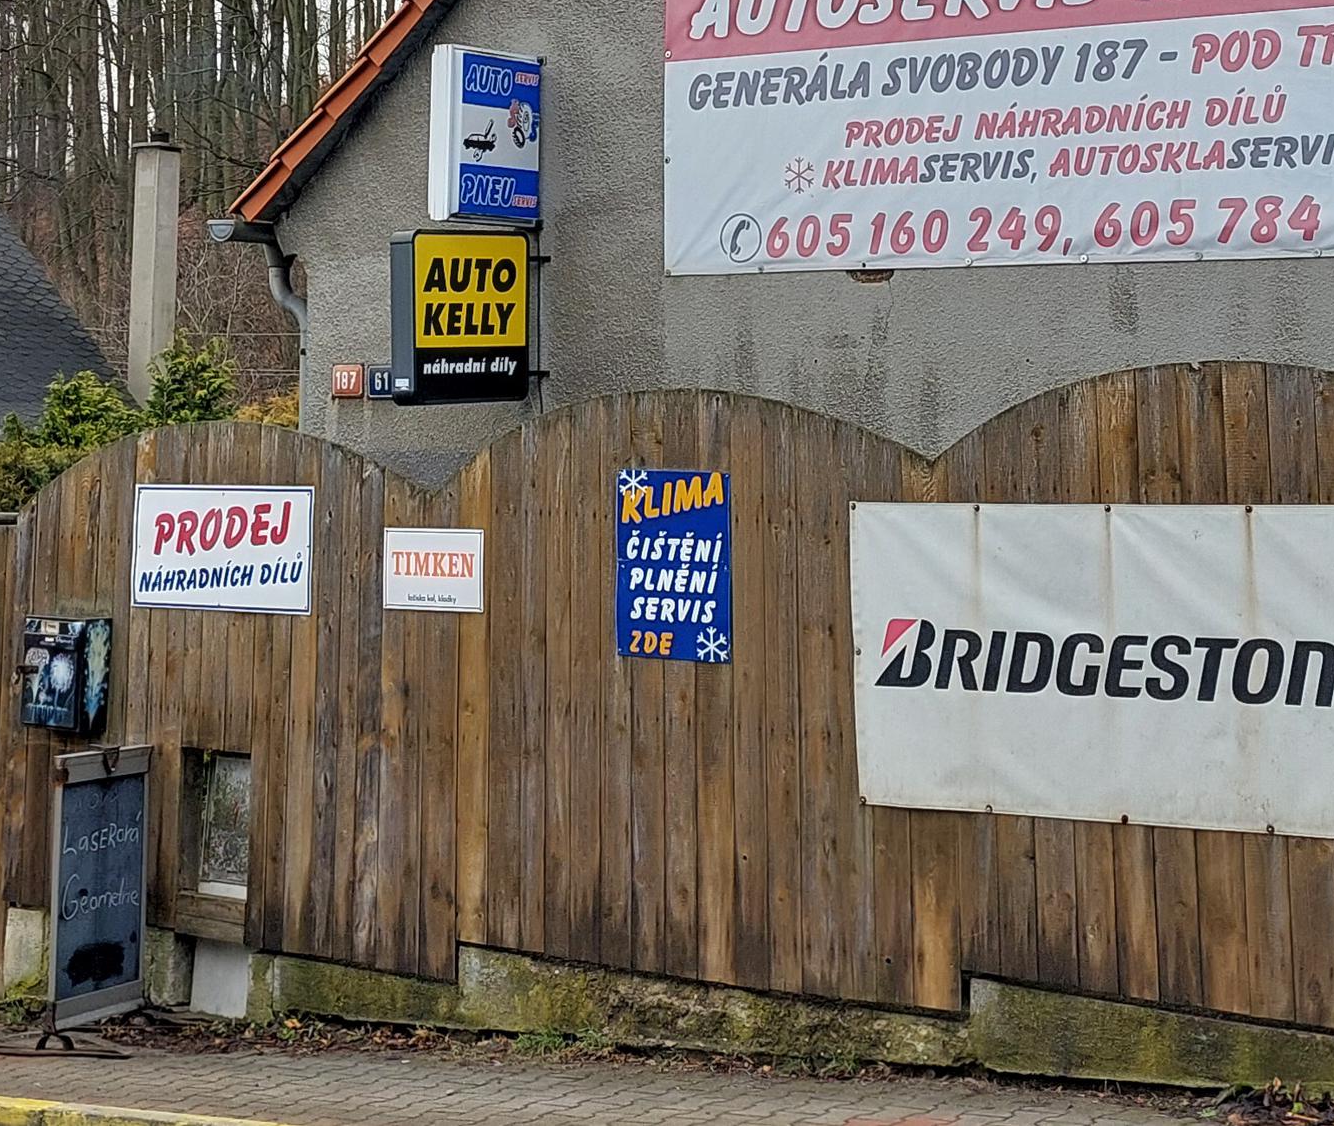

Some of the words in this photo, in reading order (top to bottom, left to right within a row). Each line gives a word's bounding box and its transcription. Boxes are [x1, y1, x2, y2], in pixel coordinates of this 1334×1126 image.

[465, 64, 514, 96] AUTO
[515, 71, 540, 87] SERVIS
[688, 52, 871, 111] GENERÁLA
[880, 45, 1065, 97] SVOBODY
[1074, 39, 1148, 83] 187
[1191, 29, 1282, 75] POD
[845, 114, 962, 149] PRODEJ
[974, 94, 1191, 141] NÁHRADNÍCH
[1204, 84, 1288, 128] DÍLŮ
[821, 149, 1037, 190] KLIMASERVIS,
[460, 173, 516, 208] PNEU
[512, 194, 538, 208] SERVIS
[767, 212, 854, 258] 605
[869, 209, 949, 255] 160
[966, 205, 1072, 256] 249,
[1093, 199, 1198, 247] 605
[1217, 194, 1321, 244] 784
[423, 257, 517, 293] AUTO
[423, 302, 516, 336] KELLY
[335, 371, 357, 390] 187
[374, 372, 389, 389] 61
[423, 358, 486, 375] náhradní
[490, 356, 517, 376] díly
[621, 472, 724, 524] KLIMA
[153, 501, 291, 556] PRODEJ
[626, 530, 723, 563] ČIŠTĚNÍ
[139, 559, 254, 593] NÁHRADNÍCH
[259, 552, 303, 586] DÍLŮ
[391, 551, 475, 578] TIMKEN
[629, 564, 719, 594] PLNĚNÍ
[630, 597, 717, 624] SERVIS
[629, 630, 674, 656] ZDE
